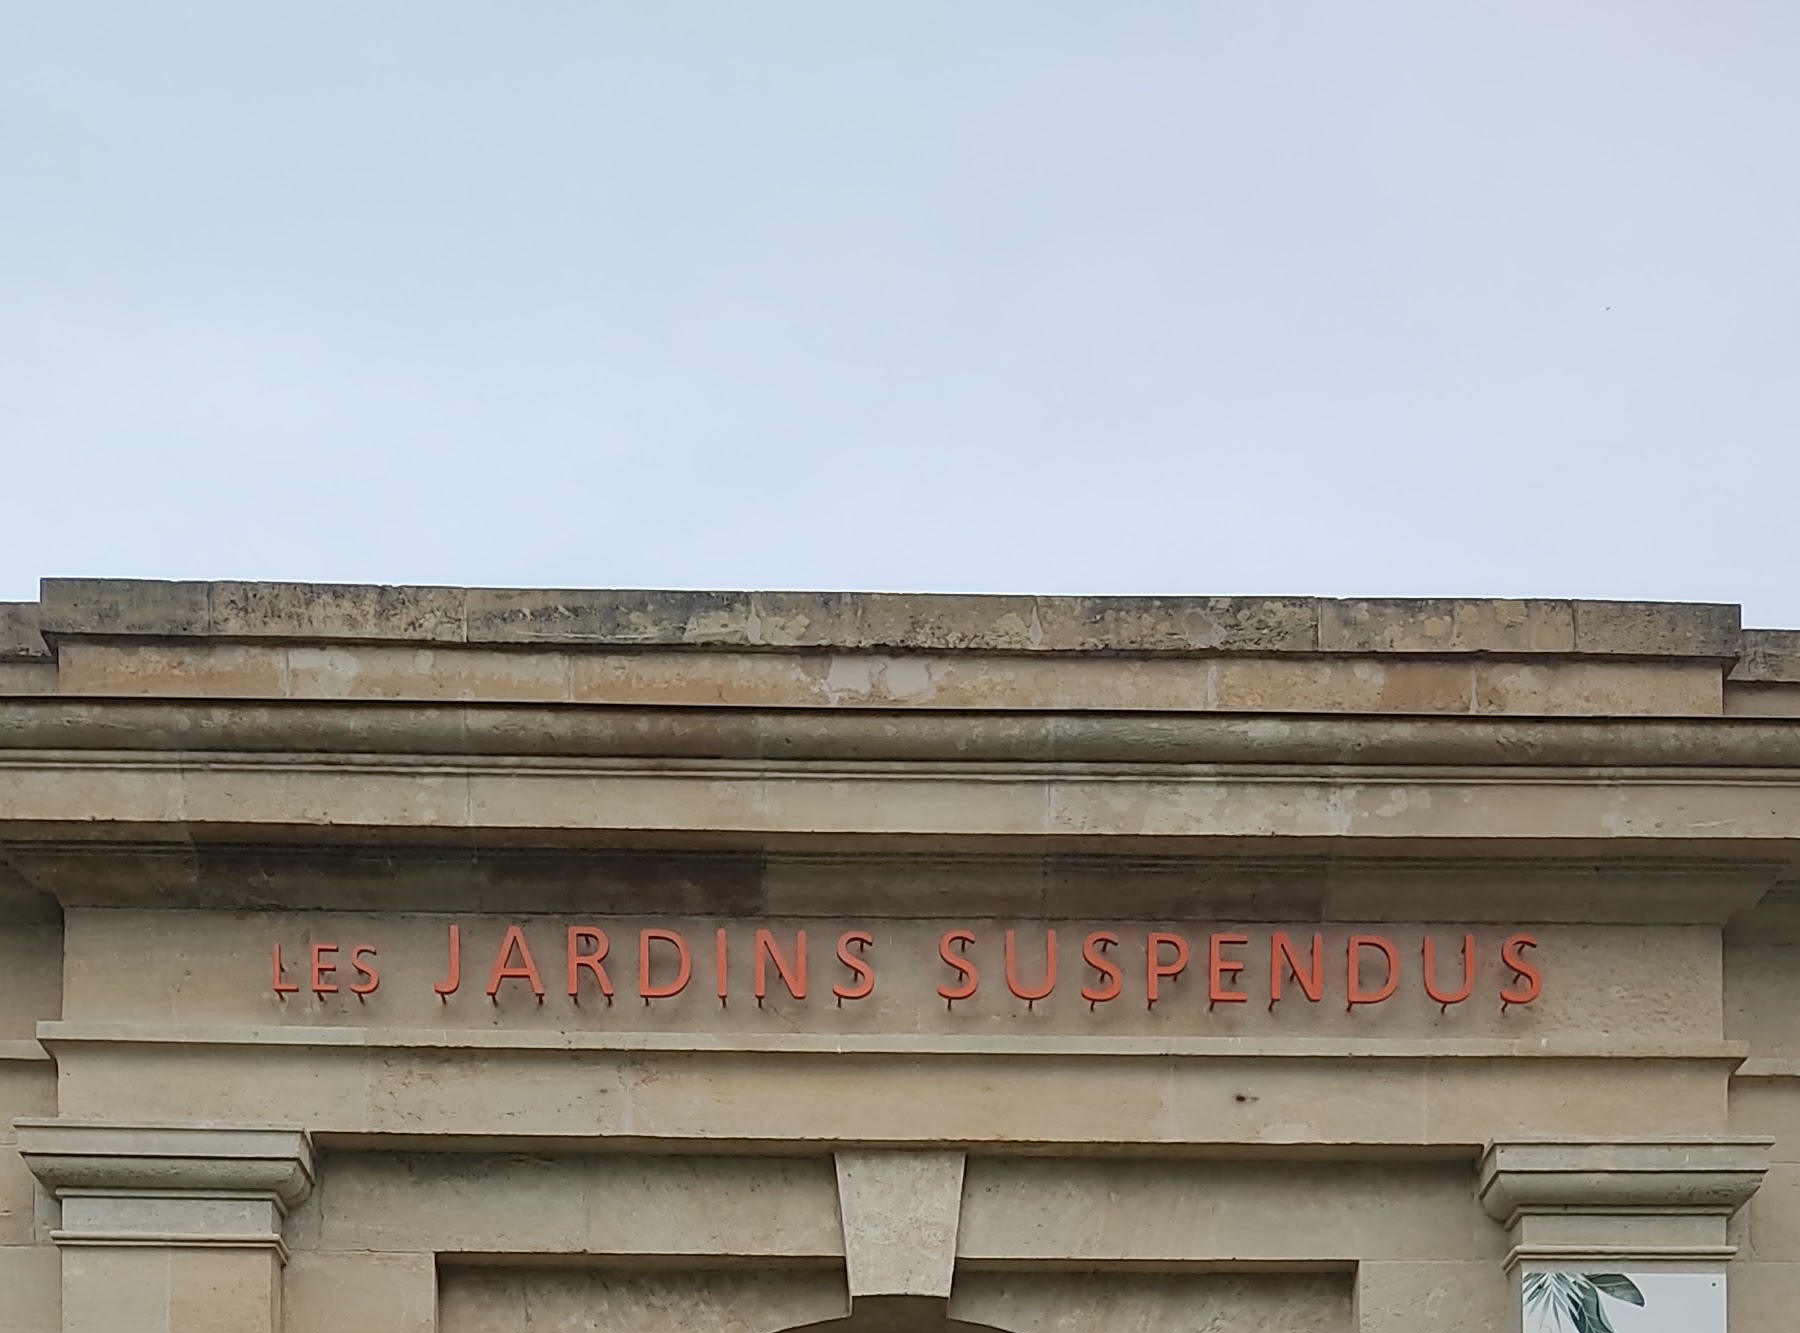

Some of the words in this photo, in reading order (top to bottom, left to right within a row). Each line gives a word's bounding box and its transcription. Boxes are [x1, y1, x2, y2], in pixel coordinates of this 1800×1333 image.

[272, 943, 380, 994] LES
[434, 923, 876, 998] JARDINS
[937, 929, 1543, 1003] SUSPENDUS
